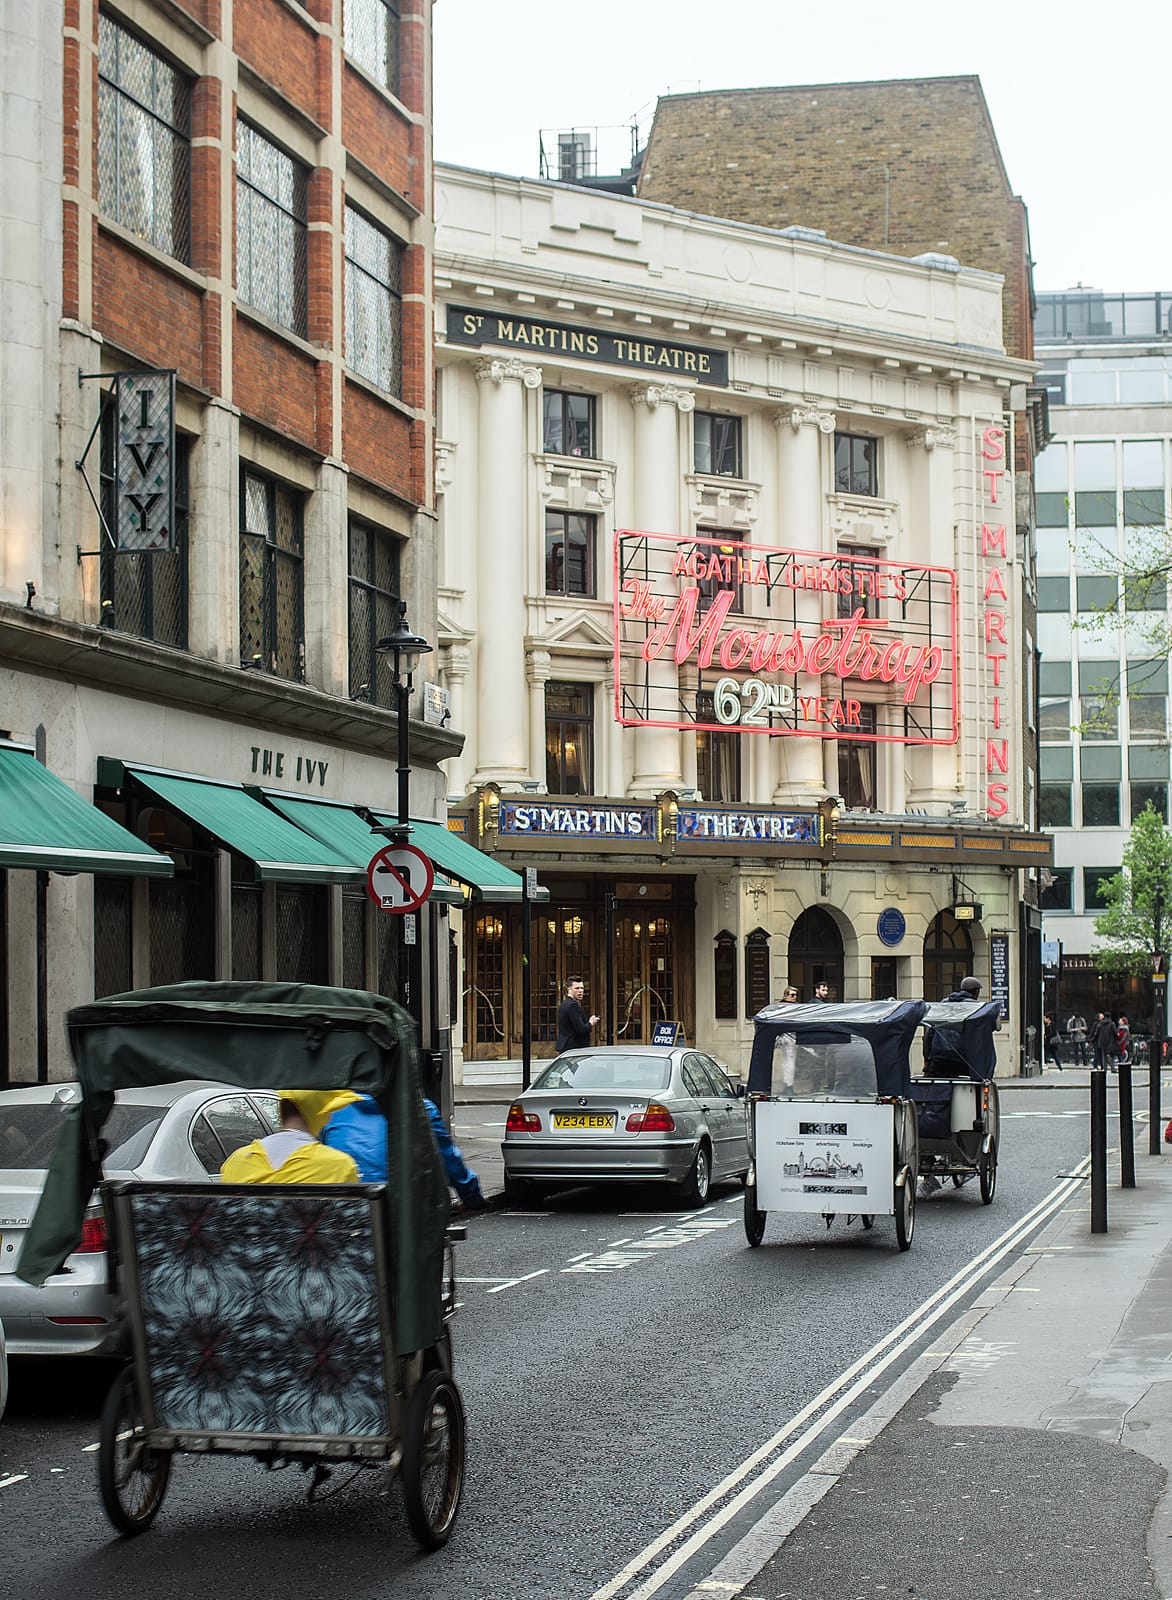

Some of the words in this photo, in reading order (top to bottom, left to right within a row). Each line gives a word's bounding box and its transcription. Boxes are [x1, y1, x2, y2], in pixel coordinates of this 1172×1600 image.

[497, 319, 599, 354] MARTINS
[613, 339, 711, 373] THEATRE
[124, 389, 165, 533] IVY
[982, 427, 1004, 503] ST
[671, 550, 772, 587] AGATHA
[785, 562, 908, 601] CHRISTIE'S
[621, 578, 668, 619] The
[641, 586, 944, 703] Mousetrap
[982, 523, 1009, 817] MARTINS
[799, 696, 862, 726] YEAR
[251, 746, 285, 778] THE
[296, 756, 329, 786] IVY
[540, 810, 643, 834] MARTIN'S
[699, 814, 799, 838] THEATRE
[1063, 958, 1094, 968] ntina
[654, 1035, 674, 1045] OFFICE
[660, 1026, 673, 1035] BOX
[555, 1116, 585, 1127] V234
[589, 1117, 613, 1127] EBX
